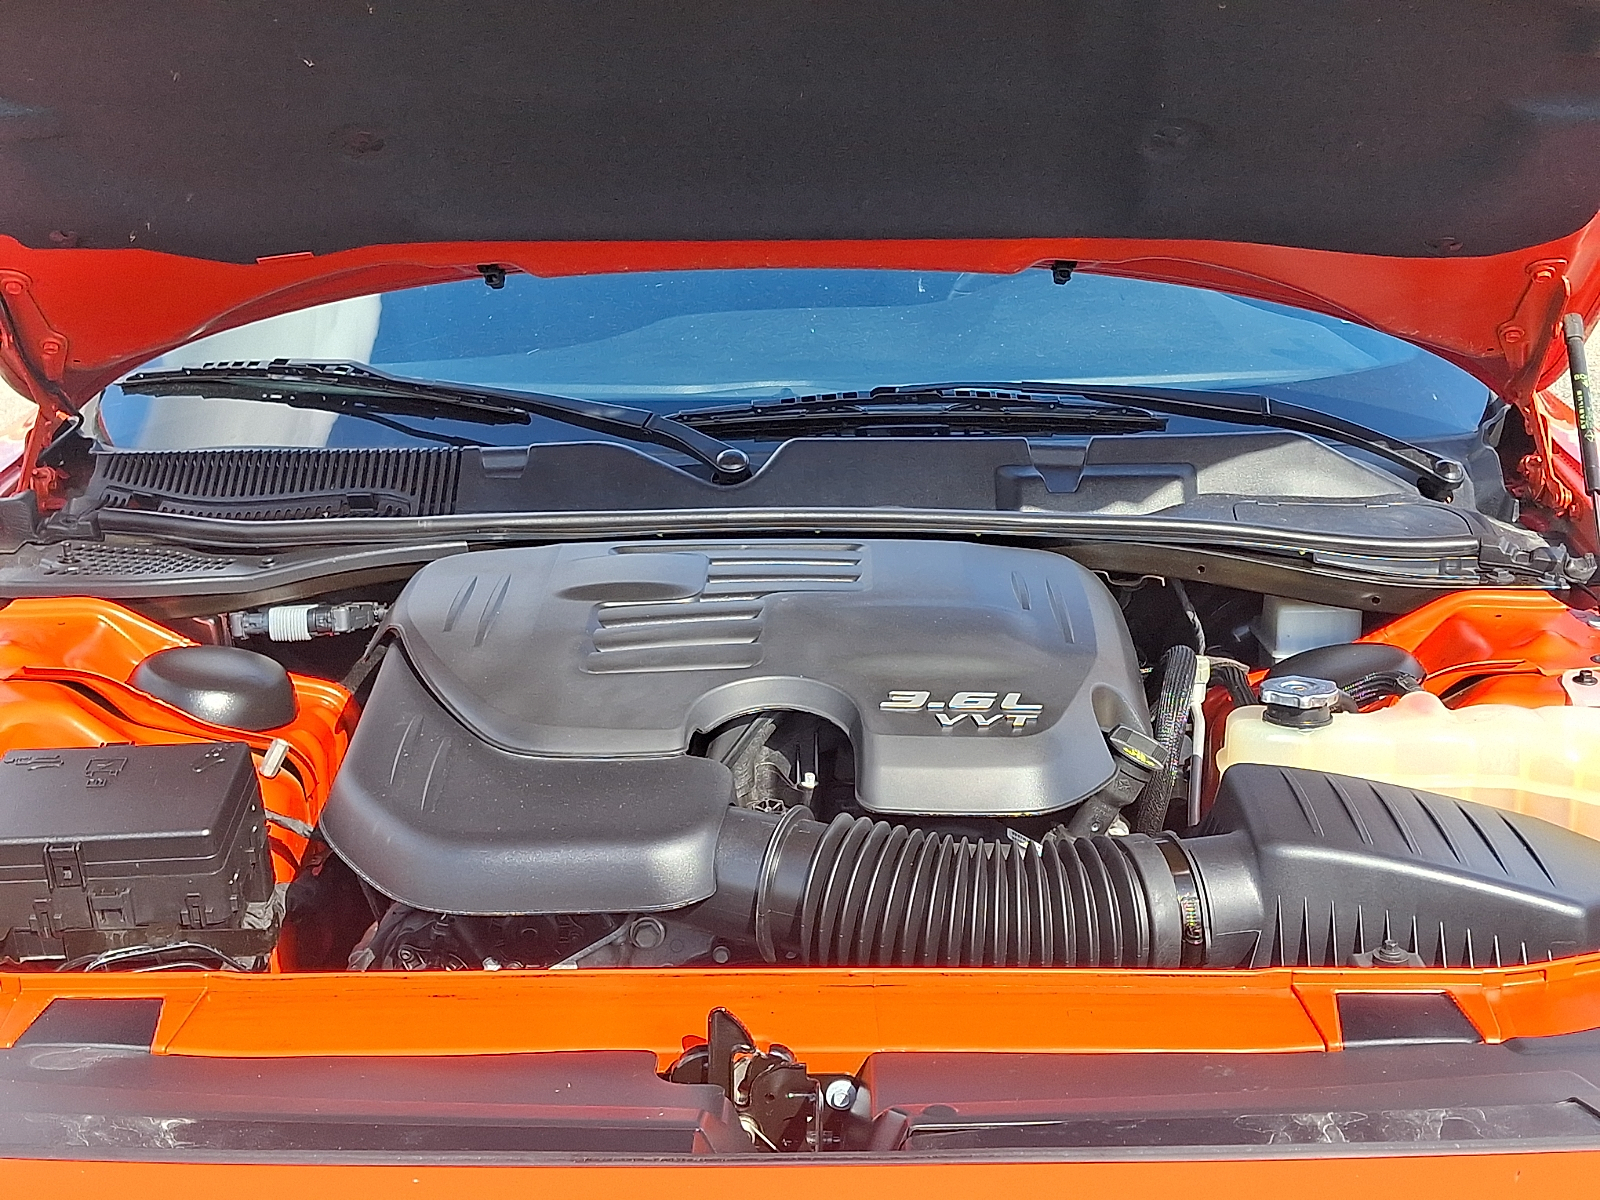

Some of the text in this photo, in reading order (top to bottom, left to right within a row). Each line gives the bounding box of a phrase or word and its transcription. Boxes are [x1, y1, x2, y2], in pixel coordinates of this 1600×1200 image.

[1577, 390, 1586, 429] STABILUS
[879, 690, 1044, 711] 3.6L
[935, 713, 1039, 728] VVT
